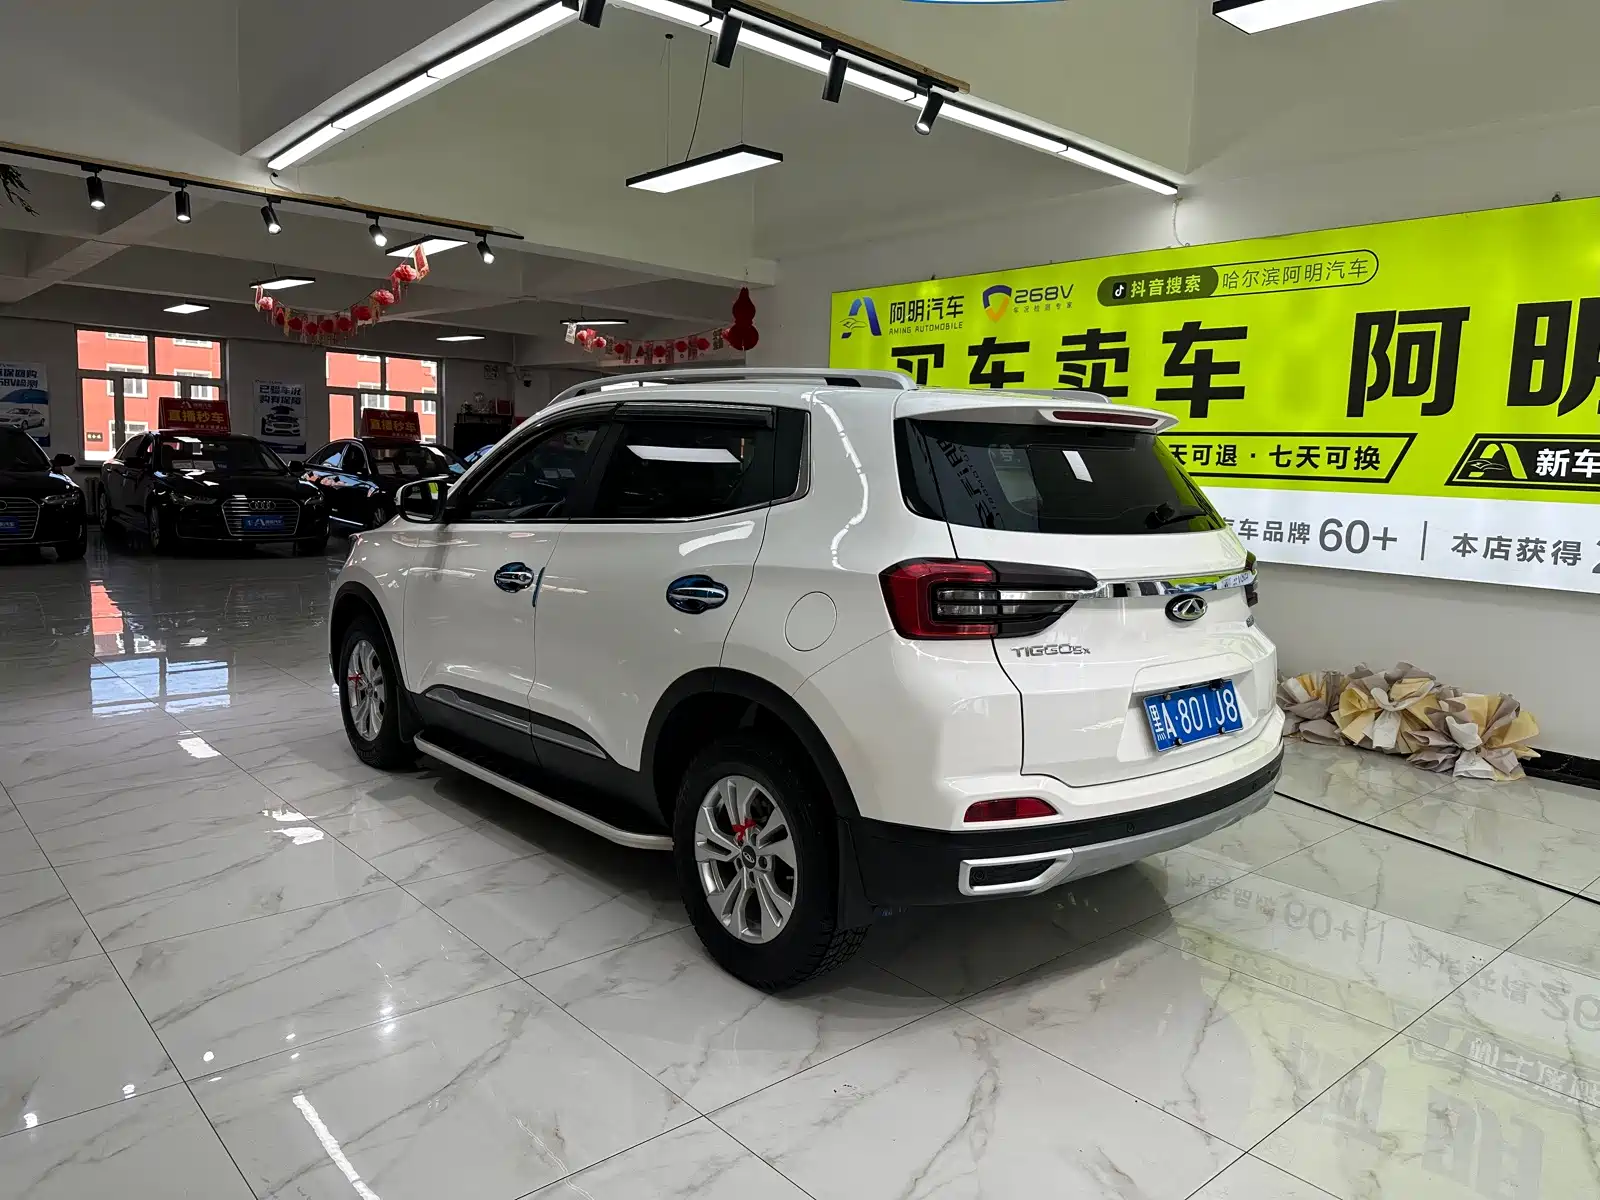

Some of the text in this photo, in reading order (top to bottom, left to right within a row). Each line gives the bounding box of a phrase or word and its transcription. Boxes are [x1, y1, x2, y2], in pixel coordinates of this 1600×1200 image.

[1130, 258, 1369, 299] 抖音搜索 哈尔滨阿明汽车
[1014, 284, 1074, 304] 268V
[889, 296, 965, 325] 阿明汽车
[888, 321, 963, 336] AMING AUTOMOBILE
[167, 409, 225, 424] 直播秒车
[1221, 517, 1398, 554] 车品牌 60+
[1451, 532, 1582, 567] 本店获得
